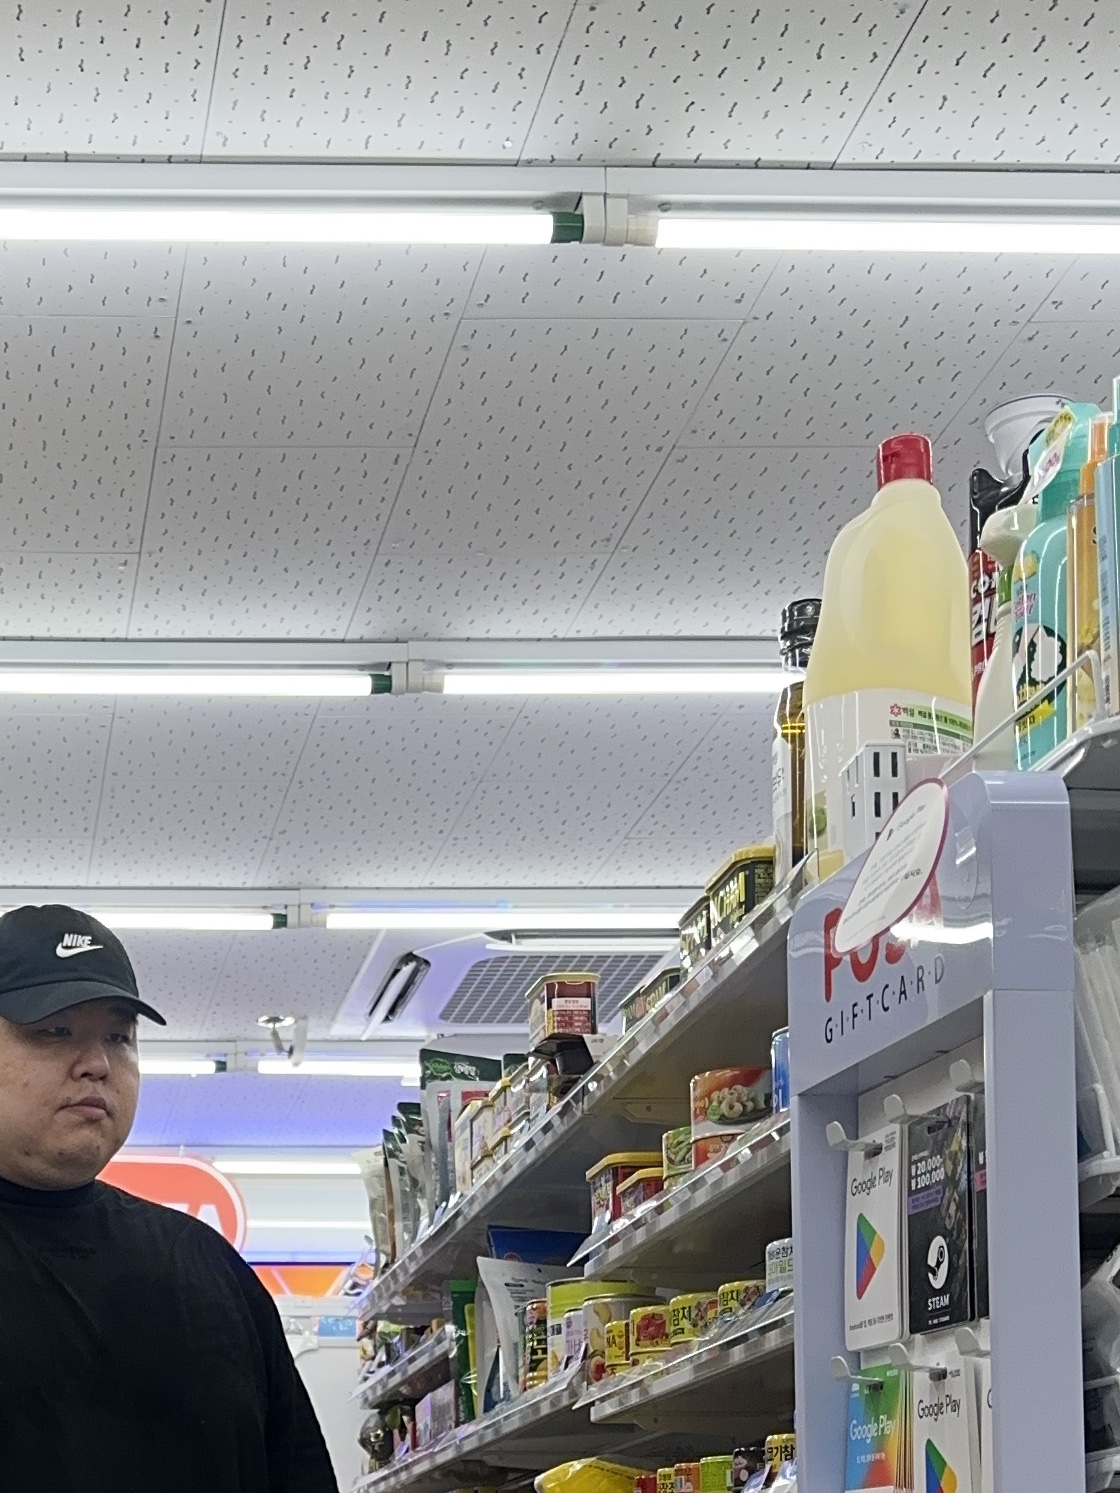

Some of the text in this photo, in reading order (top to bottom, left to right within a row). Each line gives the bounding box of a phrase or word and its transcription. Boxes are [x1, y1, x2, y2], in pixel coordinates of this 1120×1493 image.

[62, 933, 92, 948] NIKE
[851, 1167, 894, 1196] Google Play
[927, 1294, 950, 1311] STEAM
[917, 1394, 961, 1422] Google Play
[849, 1415, 895, 1443] Google Play
